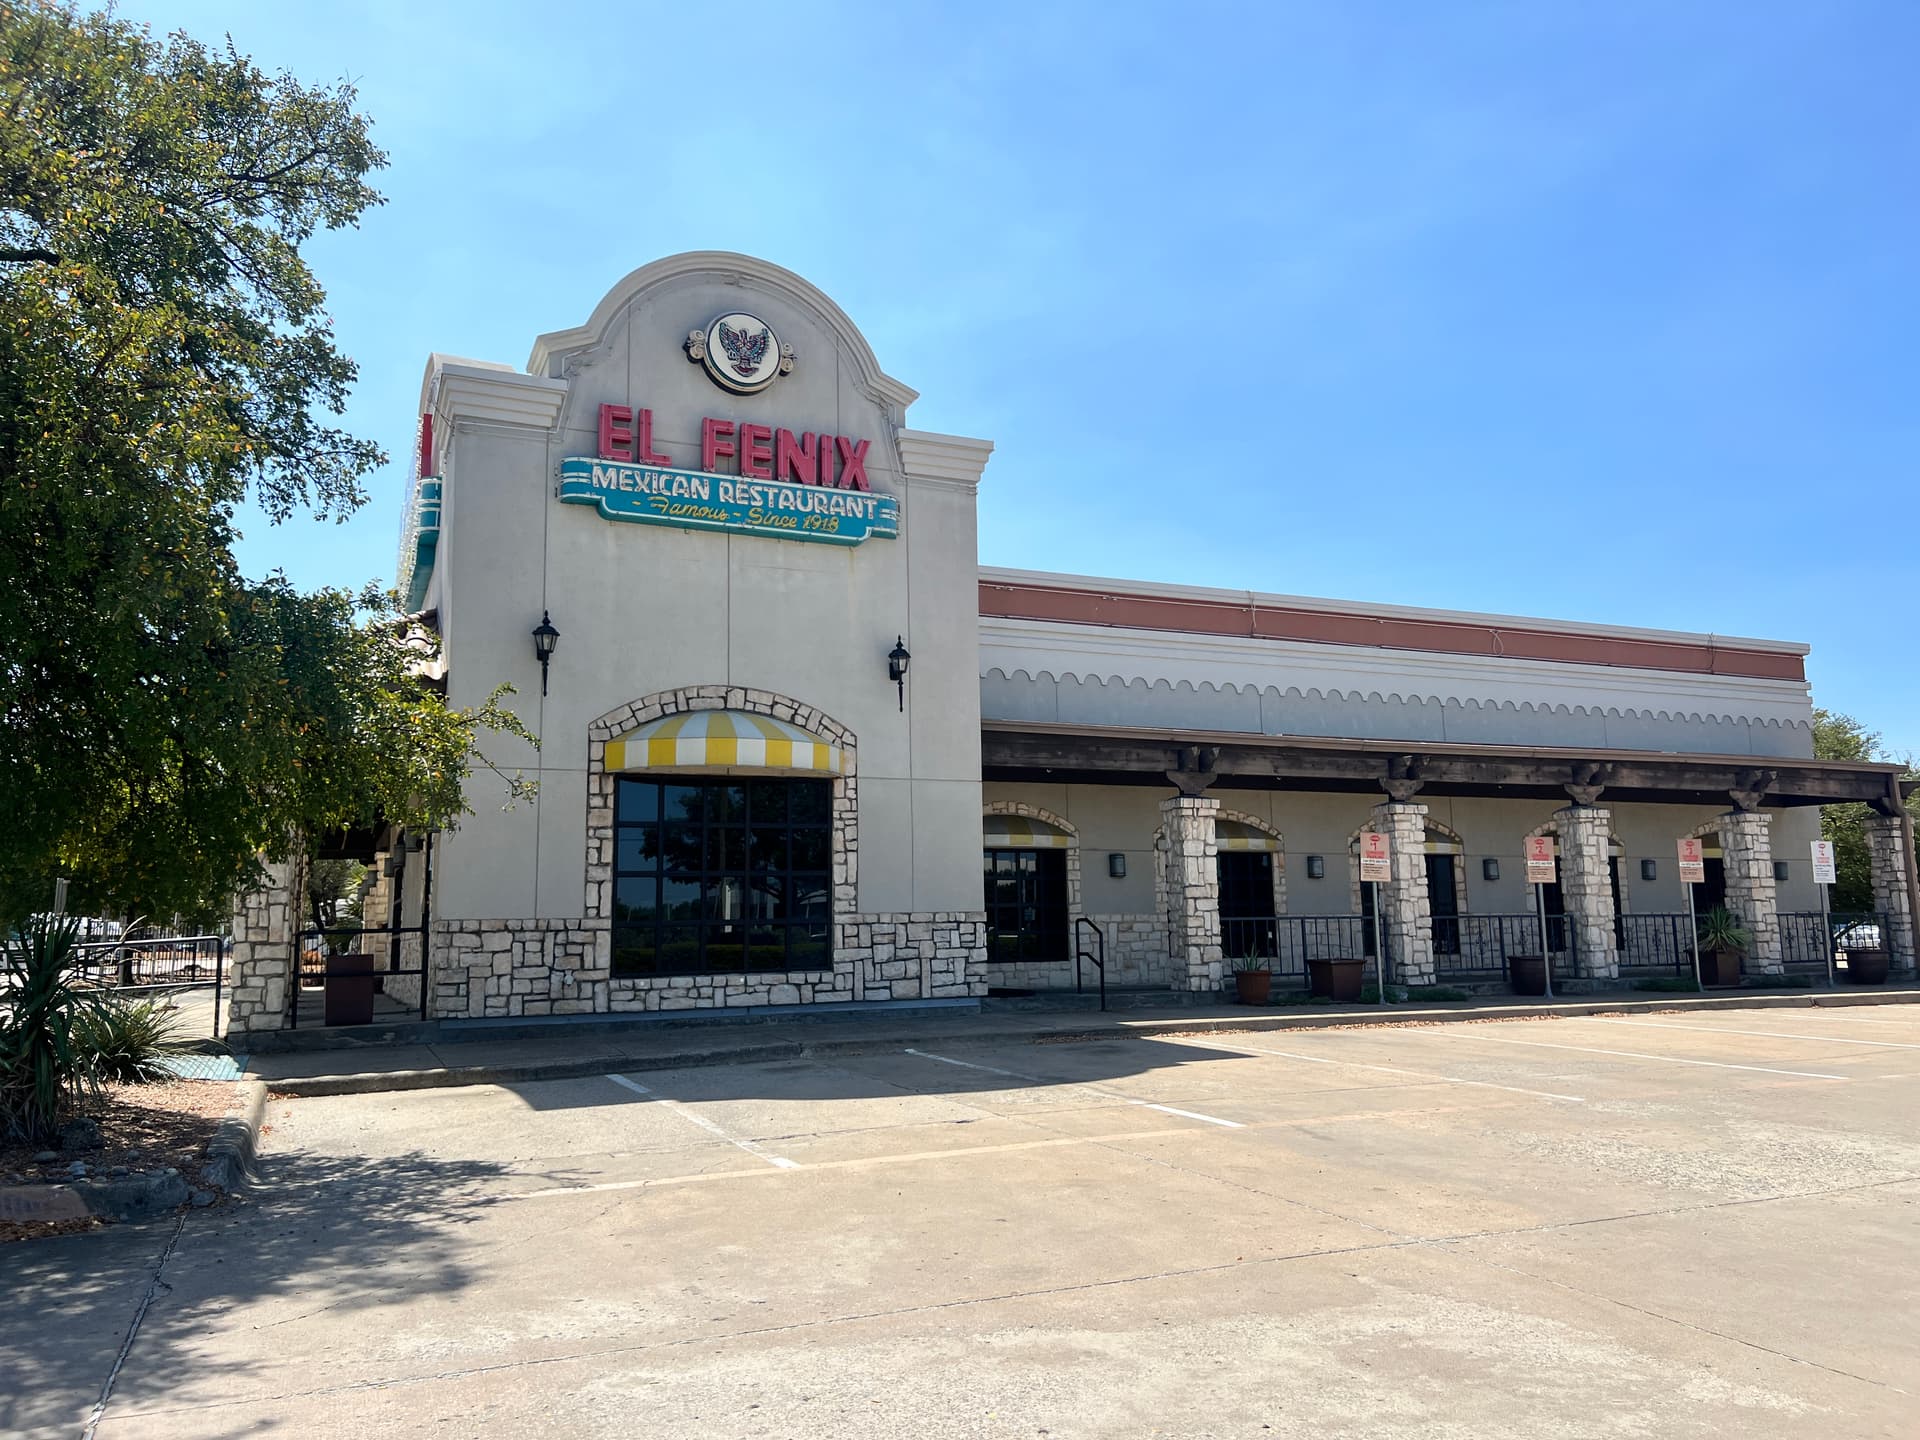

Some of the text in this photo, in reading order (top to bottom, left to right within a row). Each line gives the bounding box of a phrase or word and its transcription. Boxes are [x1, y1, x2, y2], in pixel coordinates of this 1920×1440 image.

[598, 402, 872, 492] EL FENIX
[592, 465, 877, 519] MEXICAN RESTAURANT
[647, 496, 840, 533] Famous Since 1918
